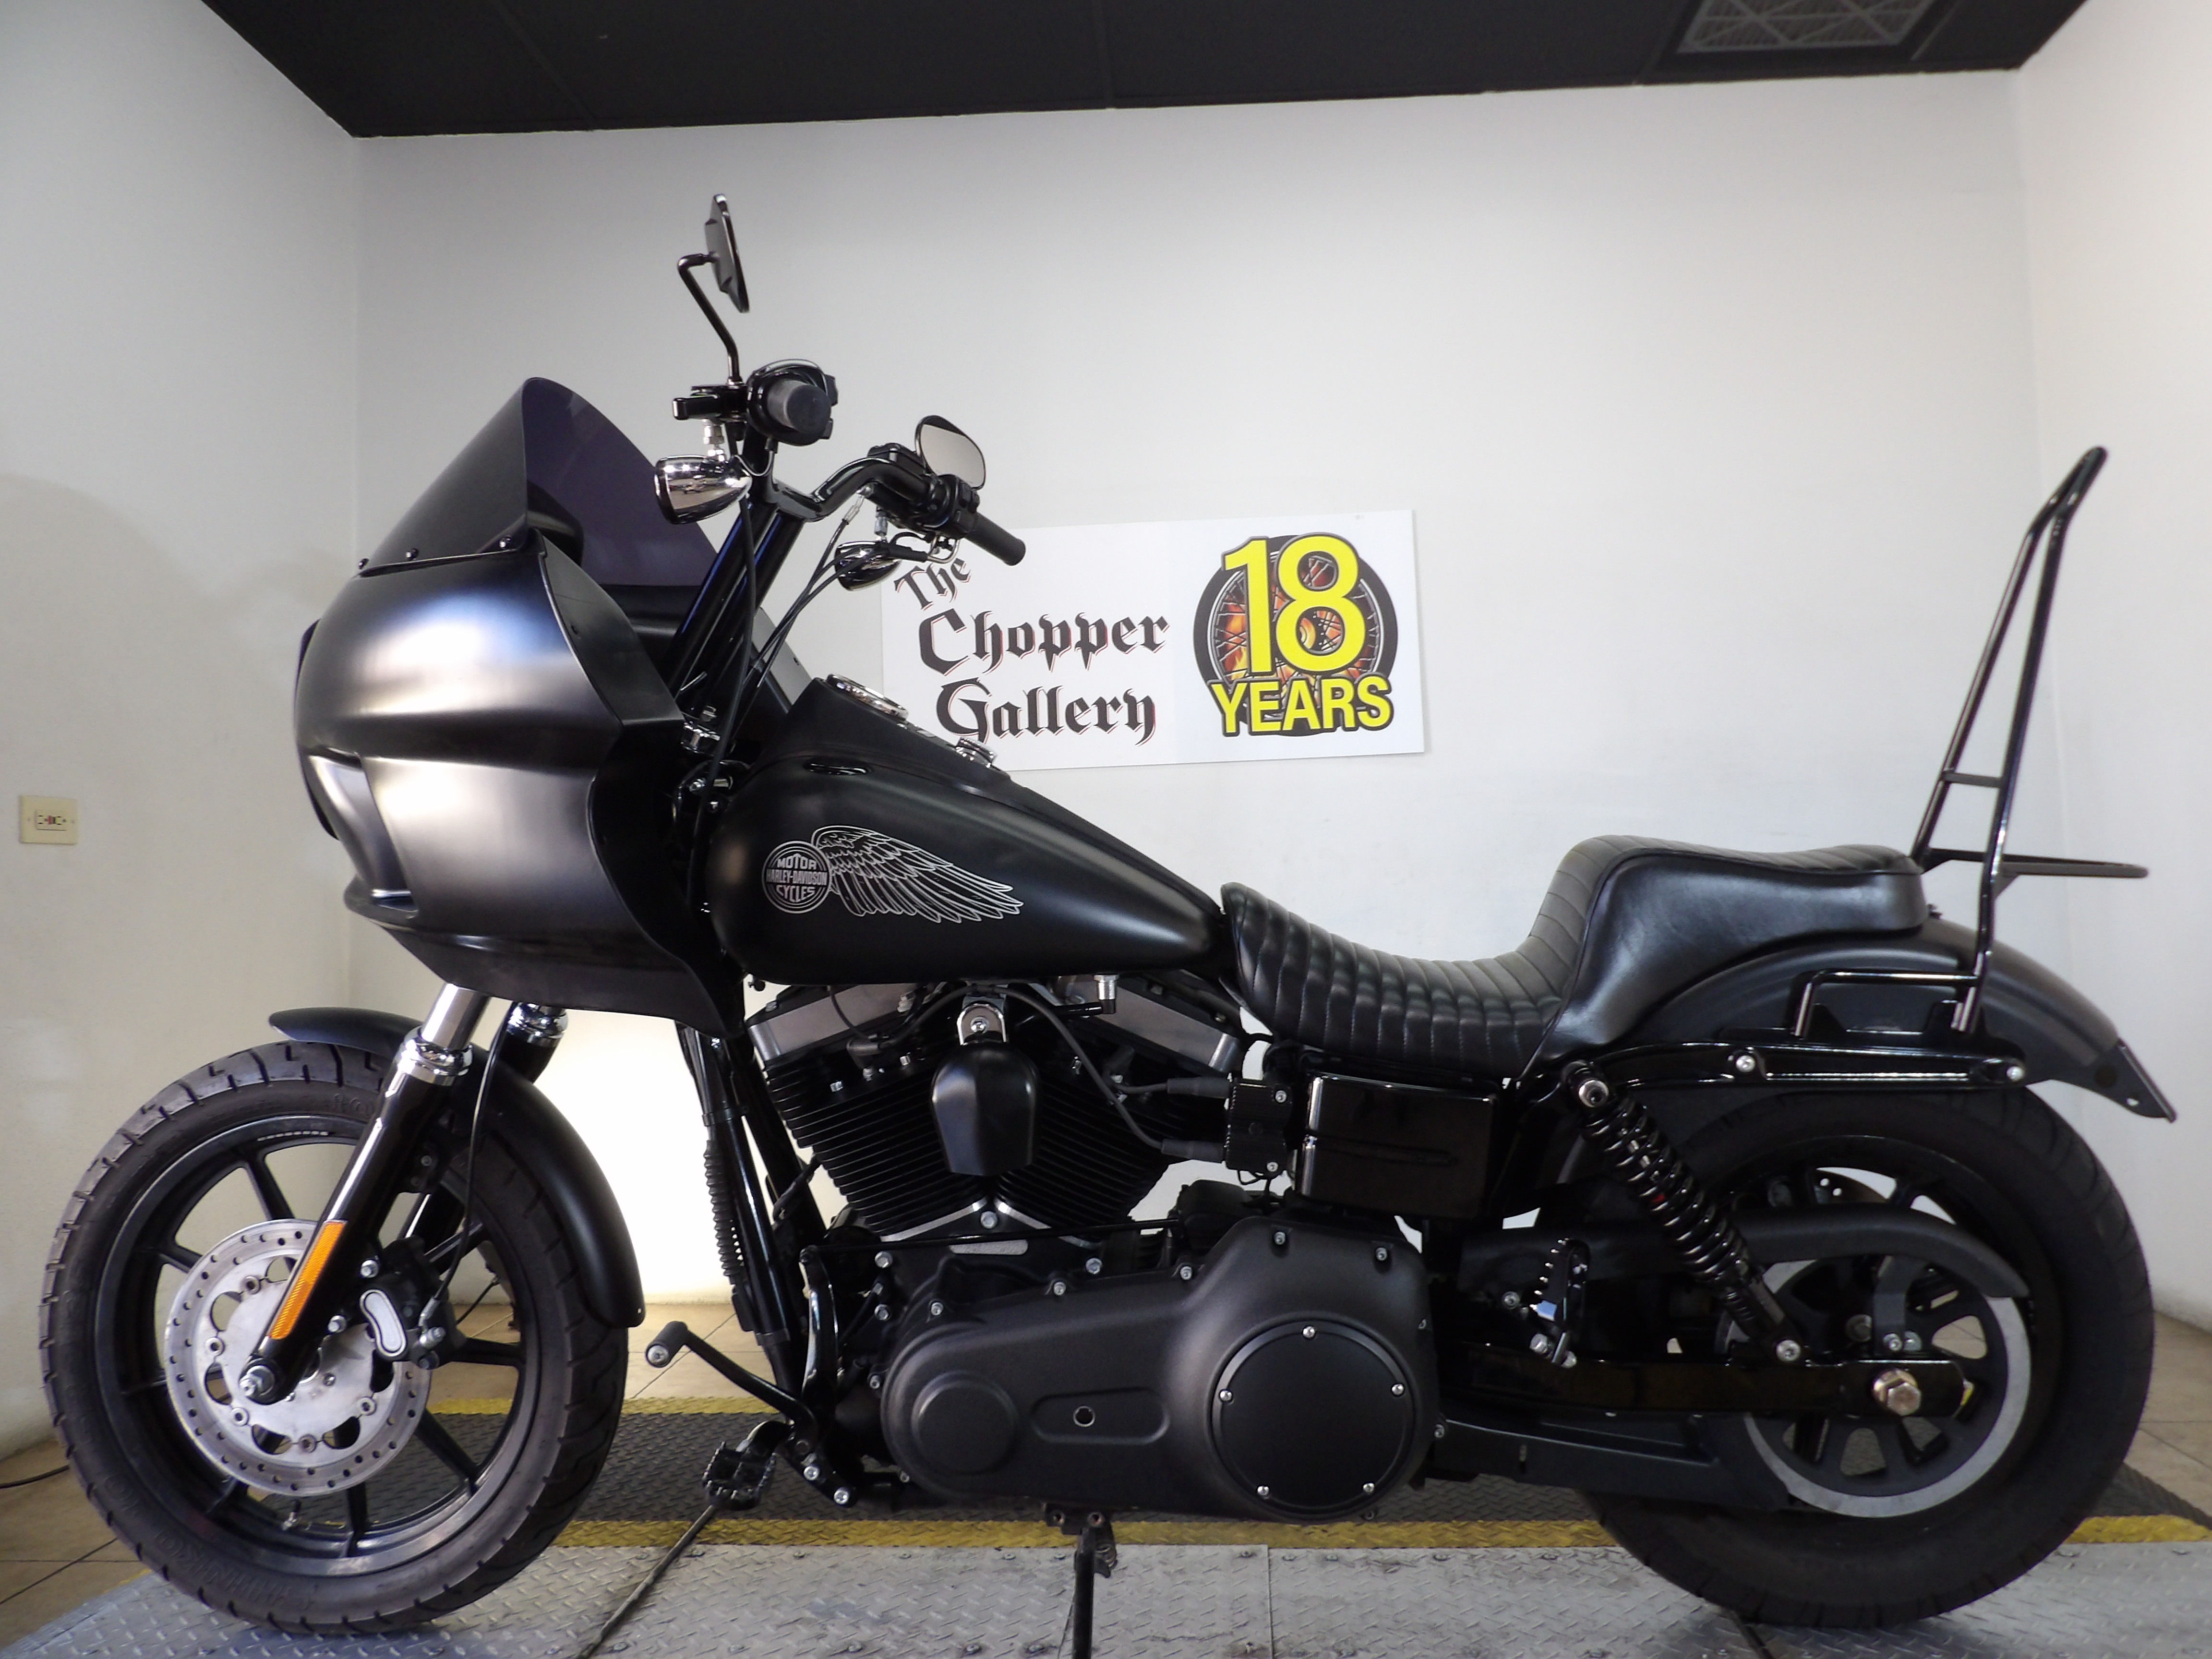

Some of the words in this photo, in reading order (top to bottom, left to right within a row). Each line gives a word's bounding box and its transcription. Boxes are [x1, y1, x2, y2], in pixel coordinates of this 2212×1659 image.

[893, 558, 971, 612] The
[1223, 534, 1367, 673] 18
[919, 609, 1170, 676] Chopper
[936, 677, 1156, 747] Gallery
[1210, 674, 1393, 734] YEARS
[766, 869, 828, 886] HARLEY-DAVIDSON
[777, 853, 817, 870] MOTOR
[776, 884, 816, 903] CYCLES
